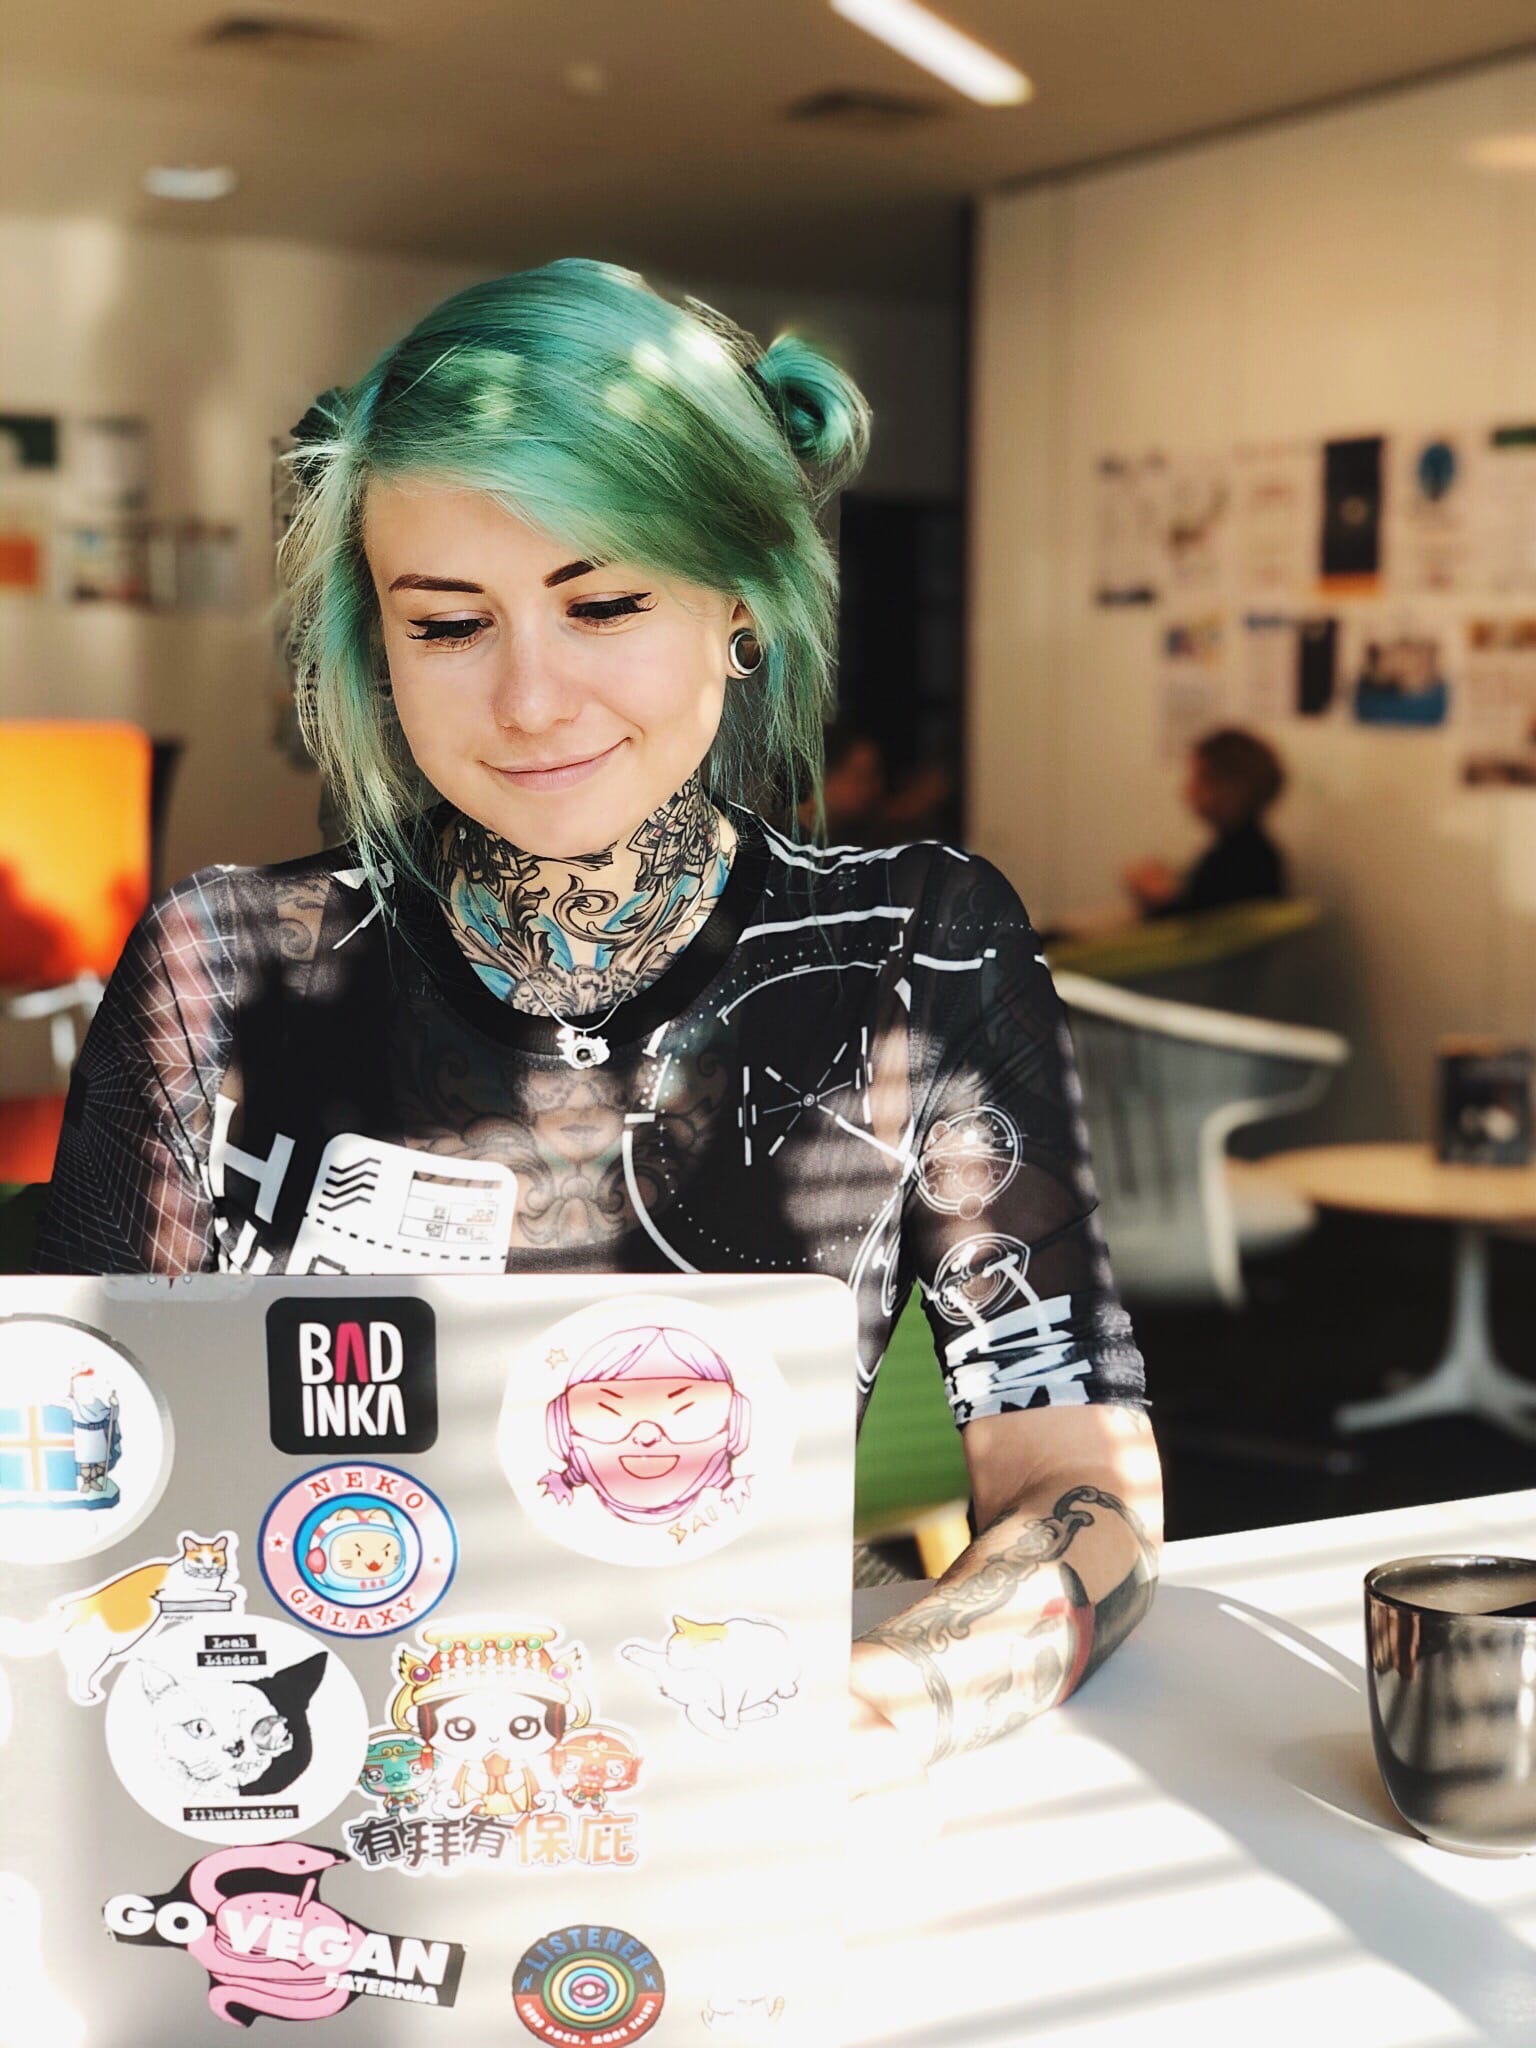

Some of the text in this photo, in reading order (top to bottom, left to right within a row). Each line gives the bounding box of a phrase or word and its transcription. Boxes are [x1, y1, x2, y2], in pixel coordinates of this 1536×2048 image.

[300, 1321, 403, 1384] BAD
[302, 1384, 407, 1437] INKA
[308, 1472, 423, 1509] NEKO
[290, 1588, 416, 1629] GALAXY
[204, 1654, 259, 1666] Linden
[212, 1637, 249, 1649] Leah
[190, 1807, 294, 1821] Illustration
[350, 1814, 638, 1866] 有拜有保庇
[104, 1893, 450, 1986] GO VEGAN
[525, 1928, 654, 1972] LISTENER
[326, 1972, 438, 2005] EATERNIA
